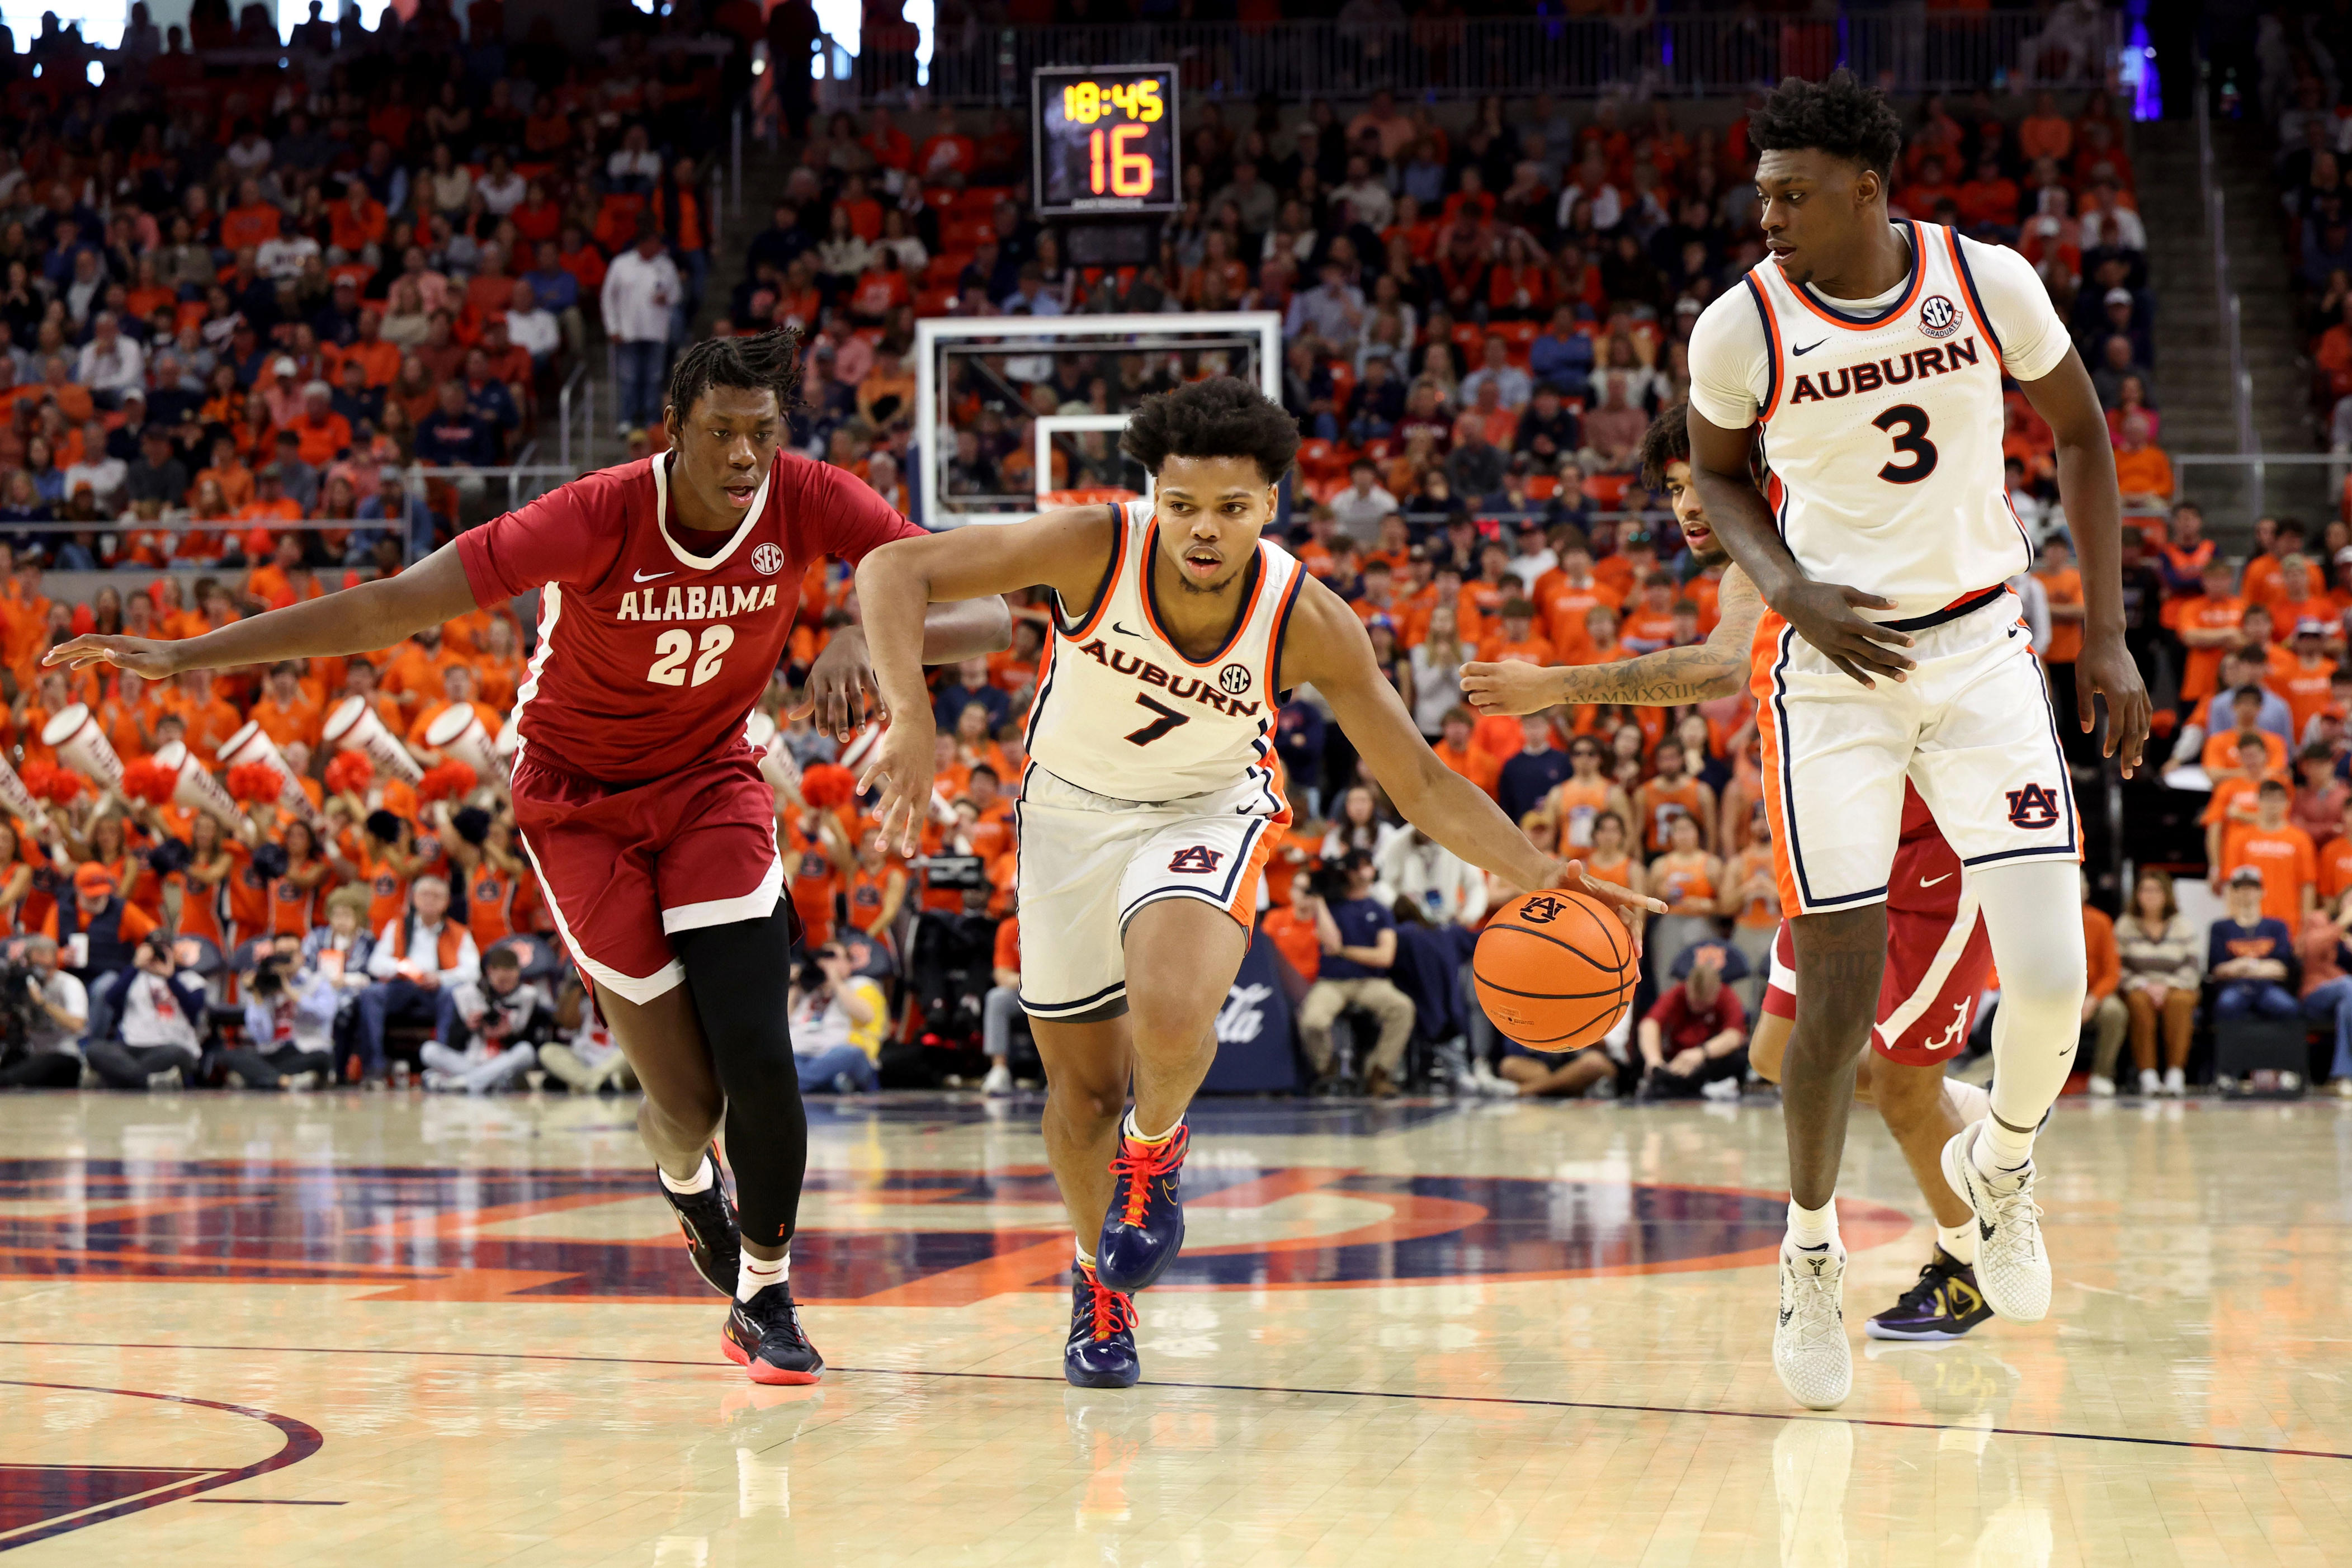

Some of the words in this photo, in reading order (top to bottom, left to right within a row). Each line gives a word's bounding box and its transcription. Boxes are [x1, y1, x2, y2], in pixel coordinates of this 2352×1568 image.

[1064, 79, 1163, 124] 18:45
[1089, 124, 1154, 197] 16
[1923, 297, 1953, 327] SEC
[1925, 319, 1959, 337] GRADUATE
[1790, 336, 1979, 405] AUBURN
[1872, 404, 1938, 484] 3
[753, 544, 783, 574] SEC
[617, 584, 777, 621] ALABAMA
[646, 624, 735, 687] 22
[1079, 638, 1261, 717] AUBURN
[1221, 665, 1250, 694] SEC
[1123, 692, 1189, 747] 7
